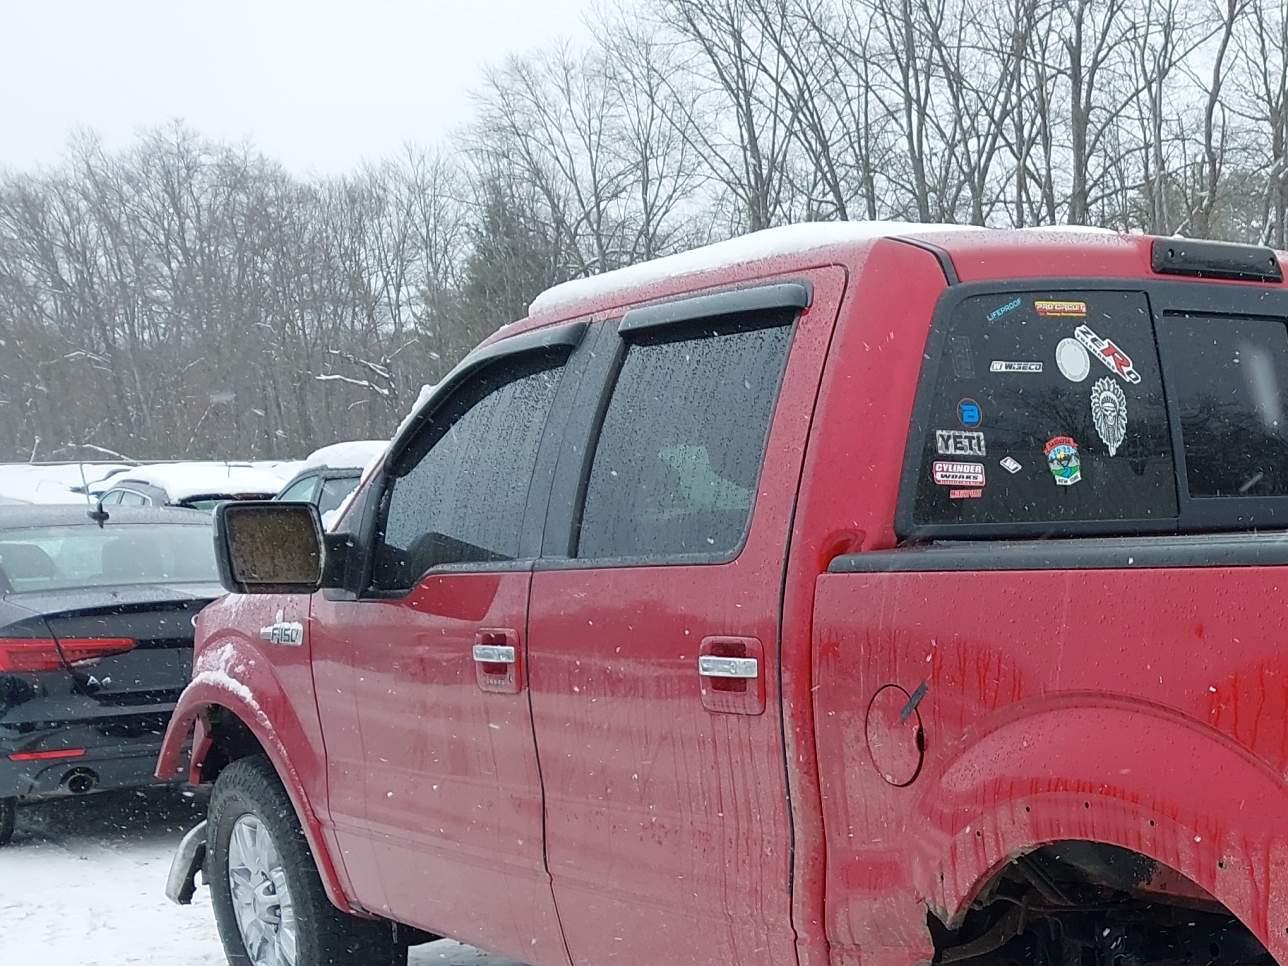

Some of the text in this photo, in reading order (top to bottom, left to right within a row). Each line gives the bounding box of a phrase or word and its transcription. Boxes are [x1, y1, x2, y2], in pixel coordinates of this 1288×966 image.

[986, 298, 1022, 321] LIFEPROOF
[939, 433, 982, 452] YETI
[935, 463, 982, 473] CYLINDER
[940, 473, 979, 481] WORKS
